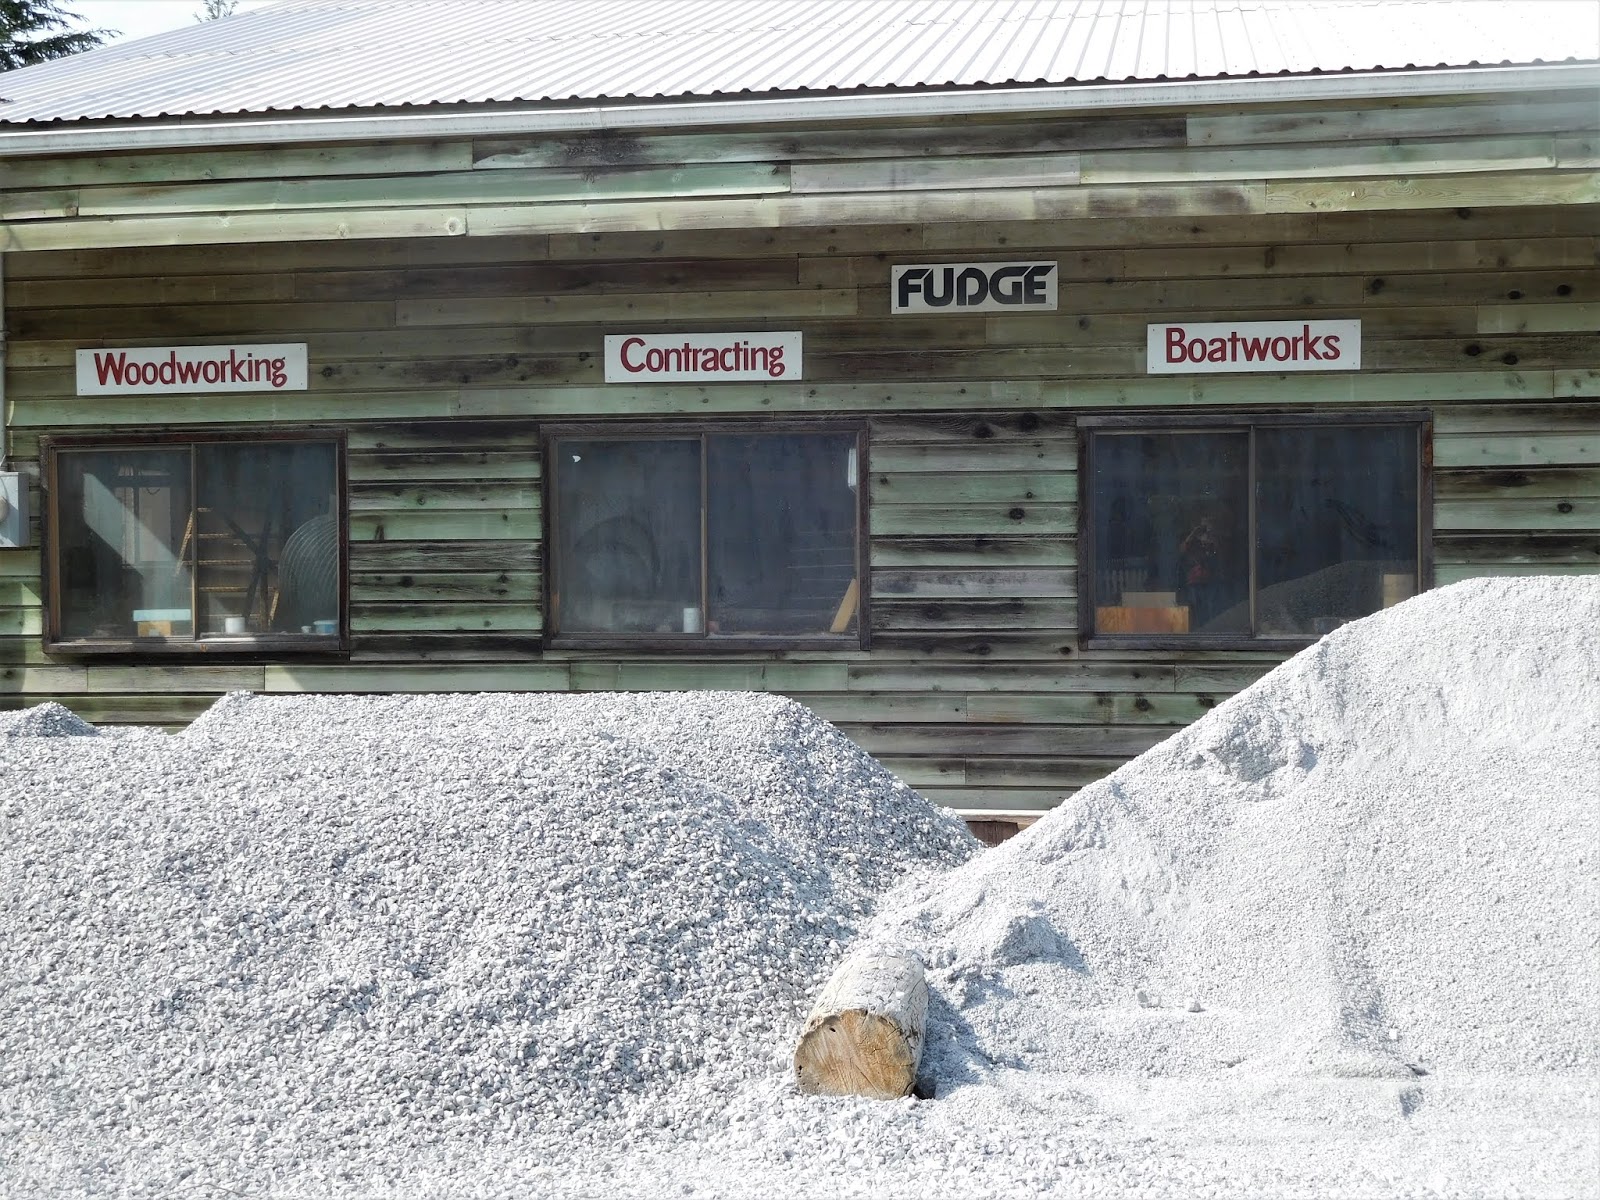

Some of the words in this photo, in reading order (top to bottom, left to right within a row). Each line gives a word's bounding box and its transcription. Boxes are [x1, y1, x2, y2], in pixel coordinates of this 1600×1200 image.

[898, 265, 1055, 307] FUDGE
[621, 337, 785, 377] Contracting
[1166, 325, 1340, 363] Boatworks
[94, 349, 287, 388] Woodworking
